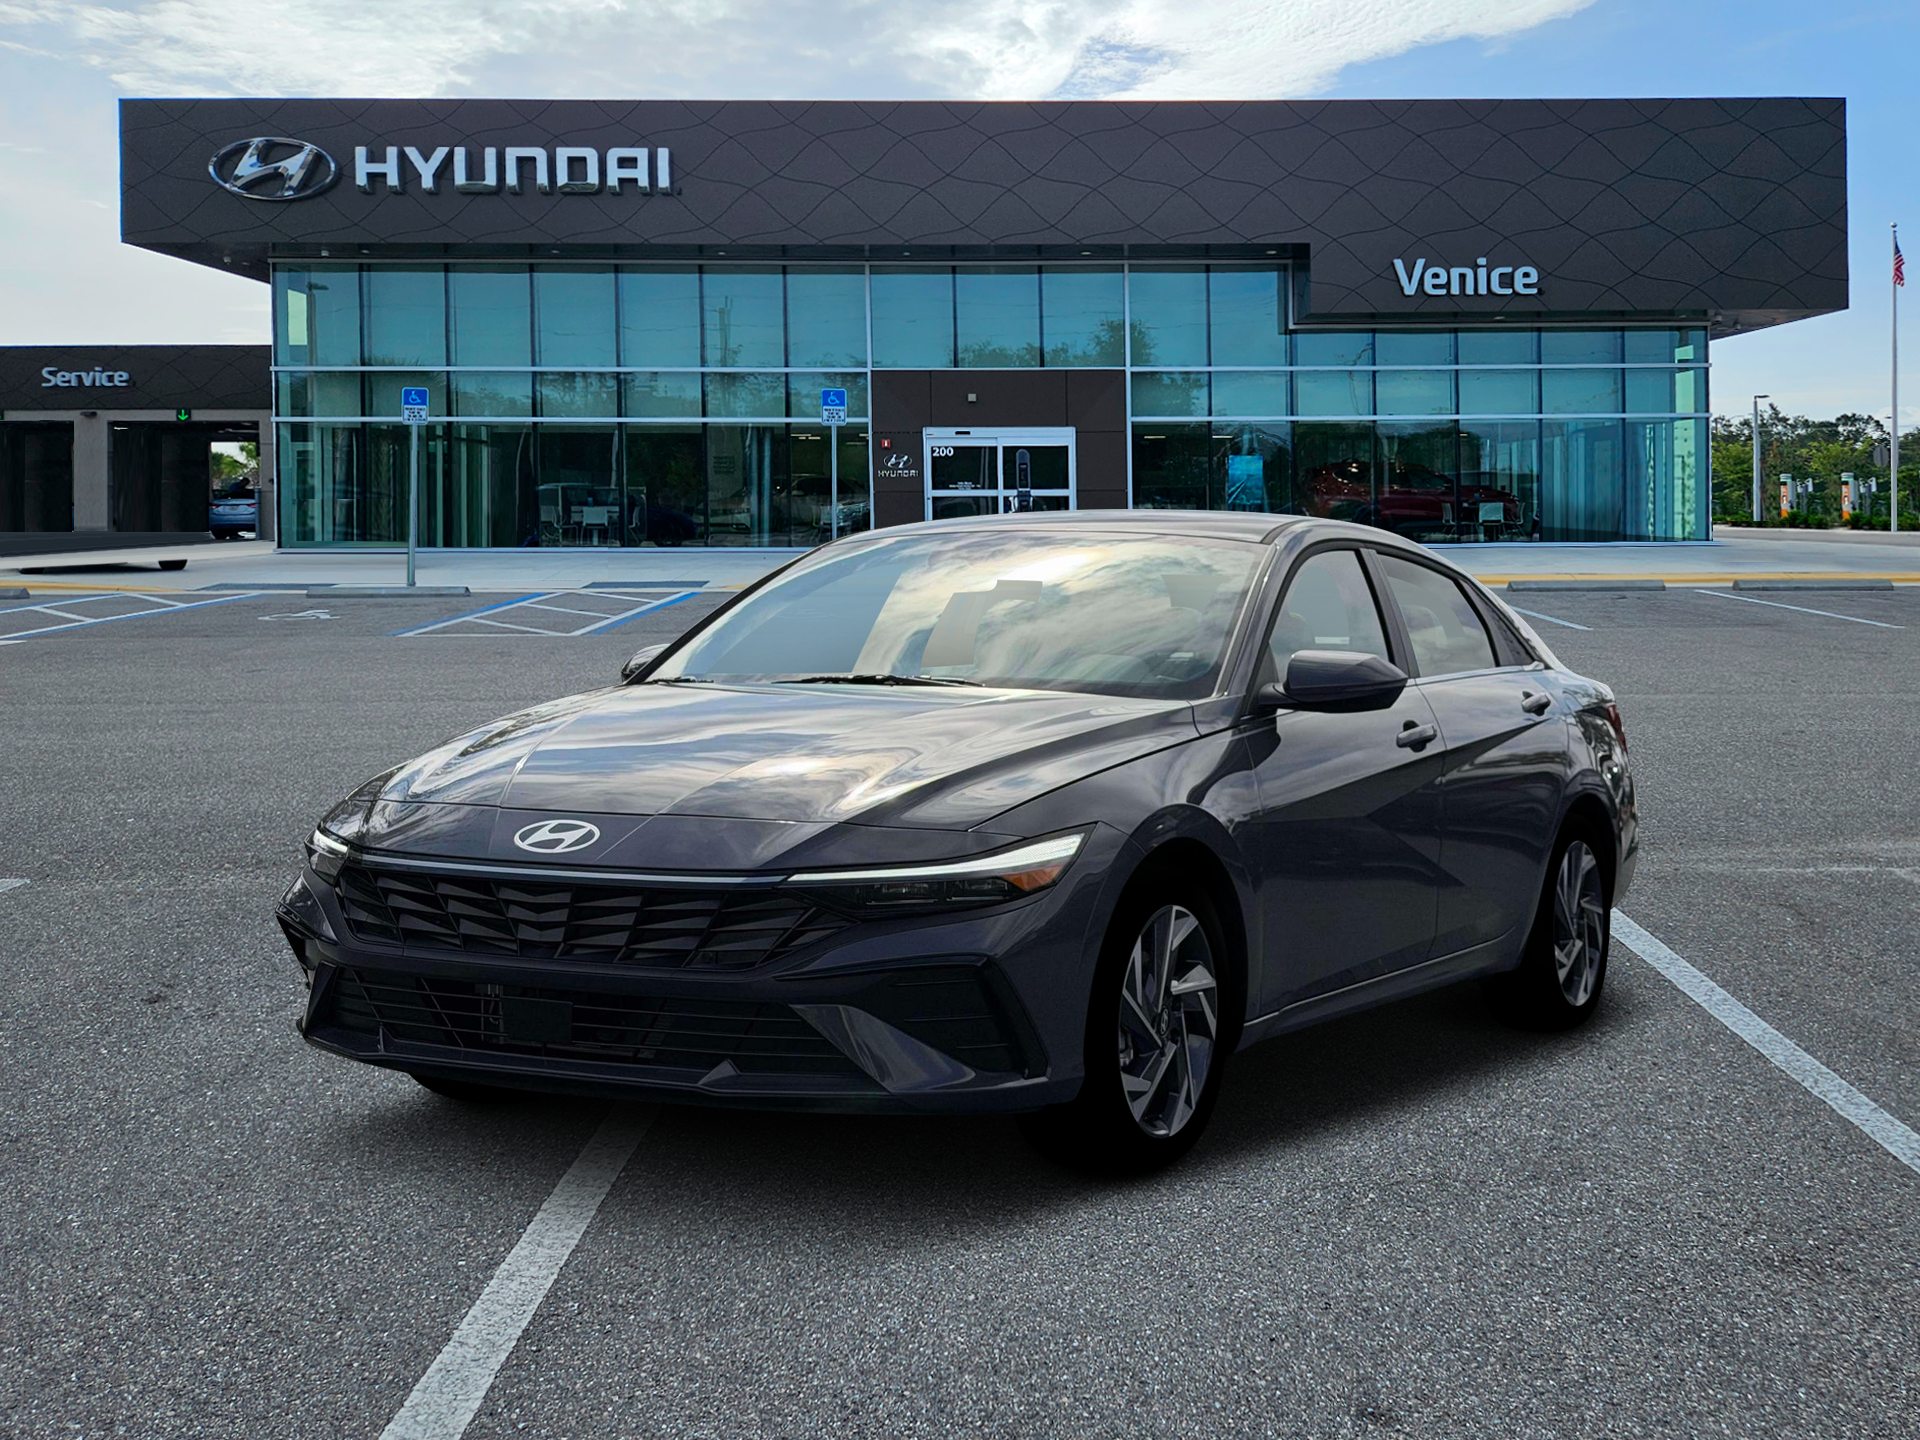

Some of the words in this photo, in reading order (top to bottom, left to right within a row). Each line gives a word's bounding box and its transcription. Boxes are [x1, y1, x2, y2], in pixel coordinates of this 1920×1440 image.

[354, 146, 672, 193] HYUNDAI
[1392, 257, 1539, 295] Venice
[41, 366, 130, 387] Service
[932, 446, 954, 457] 200
[877, 470, 919, 478] HYUNDAI
